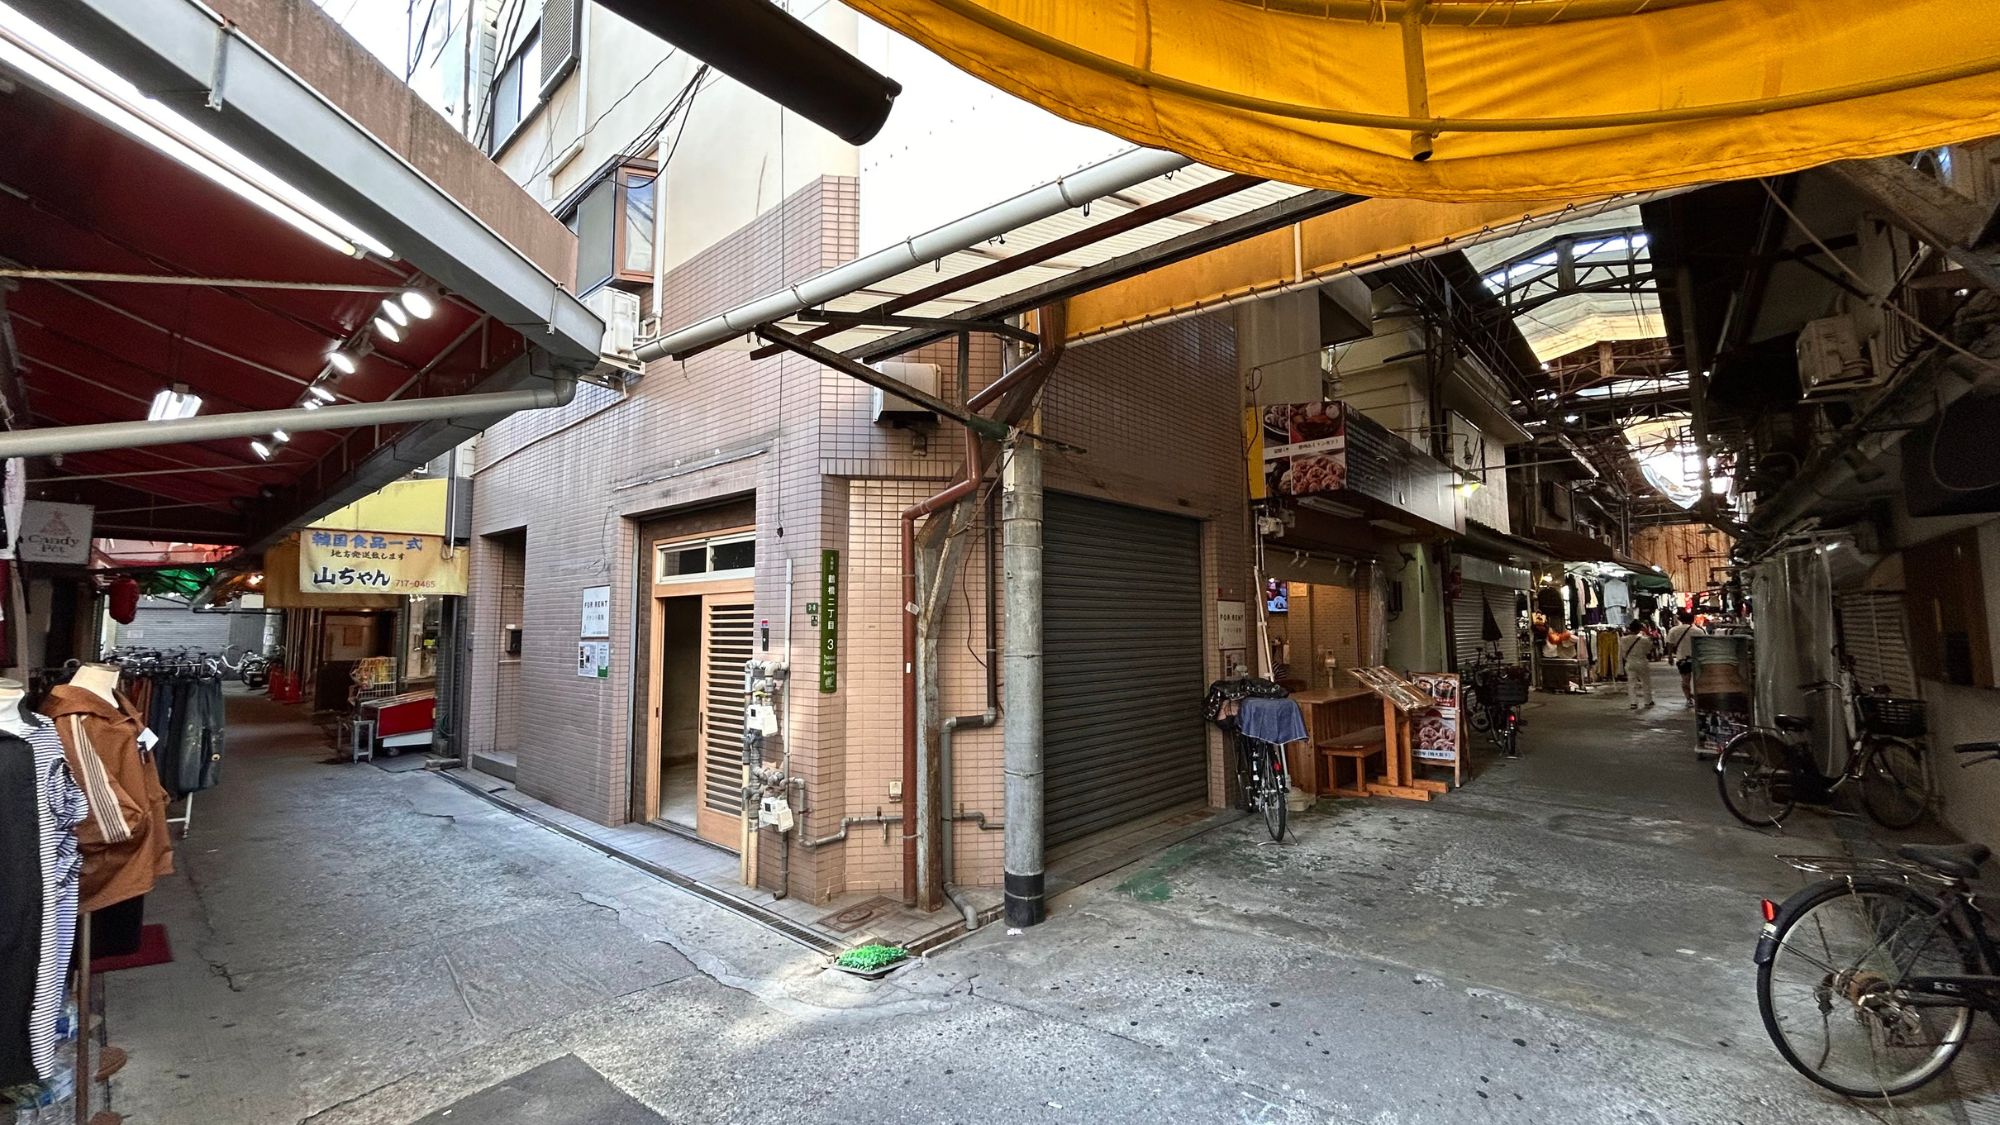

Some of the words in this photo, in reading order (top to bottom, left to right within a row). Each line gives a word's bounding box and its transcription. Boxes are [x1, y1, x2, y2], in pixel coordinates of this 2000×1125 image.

[28, 534, 79, 547] Candy
[312, 531, 423, 551] 韓国食品一式
[313, 567, 390, 587] 山ちゃん
[827, 638, 834, 650] 3
